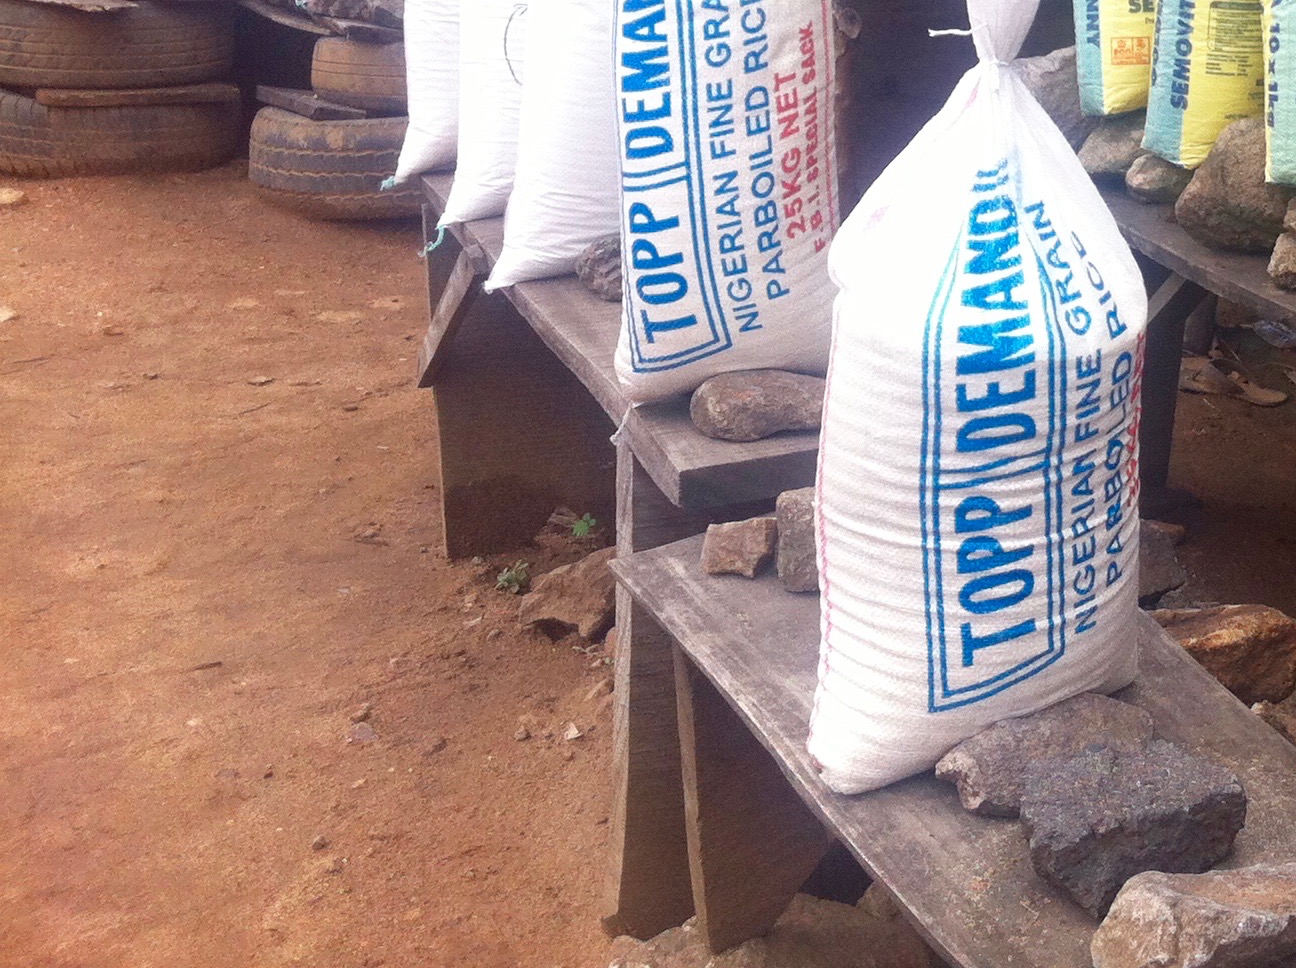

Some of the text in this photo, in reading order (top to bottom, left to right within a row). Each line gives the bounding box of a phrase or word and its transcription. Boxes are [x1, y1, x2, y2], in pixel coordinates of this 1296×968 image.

[799, 20, 818, 85] SACK
[1269, 22, 1281, 54] 10
[706, 78, 738, 161] FINE
[744, 84, 790, 302] PARBOILED
[773, 72, 807, 240] 25KG NET
[803, 86, 819, 183] SPECIAL
[629, 201, 697, 344] TOPP
[712, 168, 762, 332] NIGERIAN
[955, 194, 1036, 667] TOPP DEMAND
[1023, 199, 1103, 635] NIGERIAN FINE GRAIN
